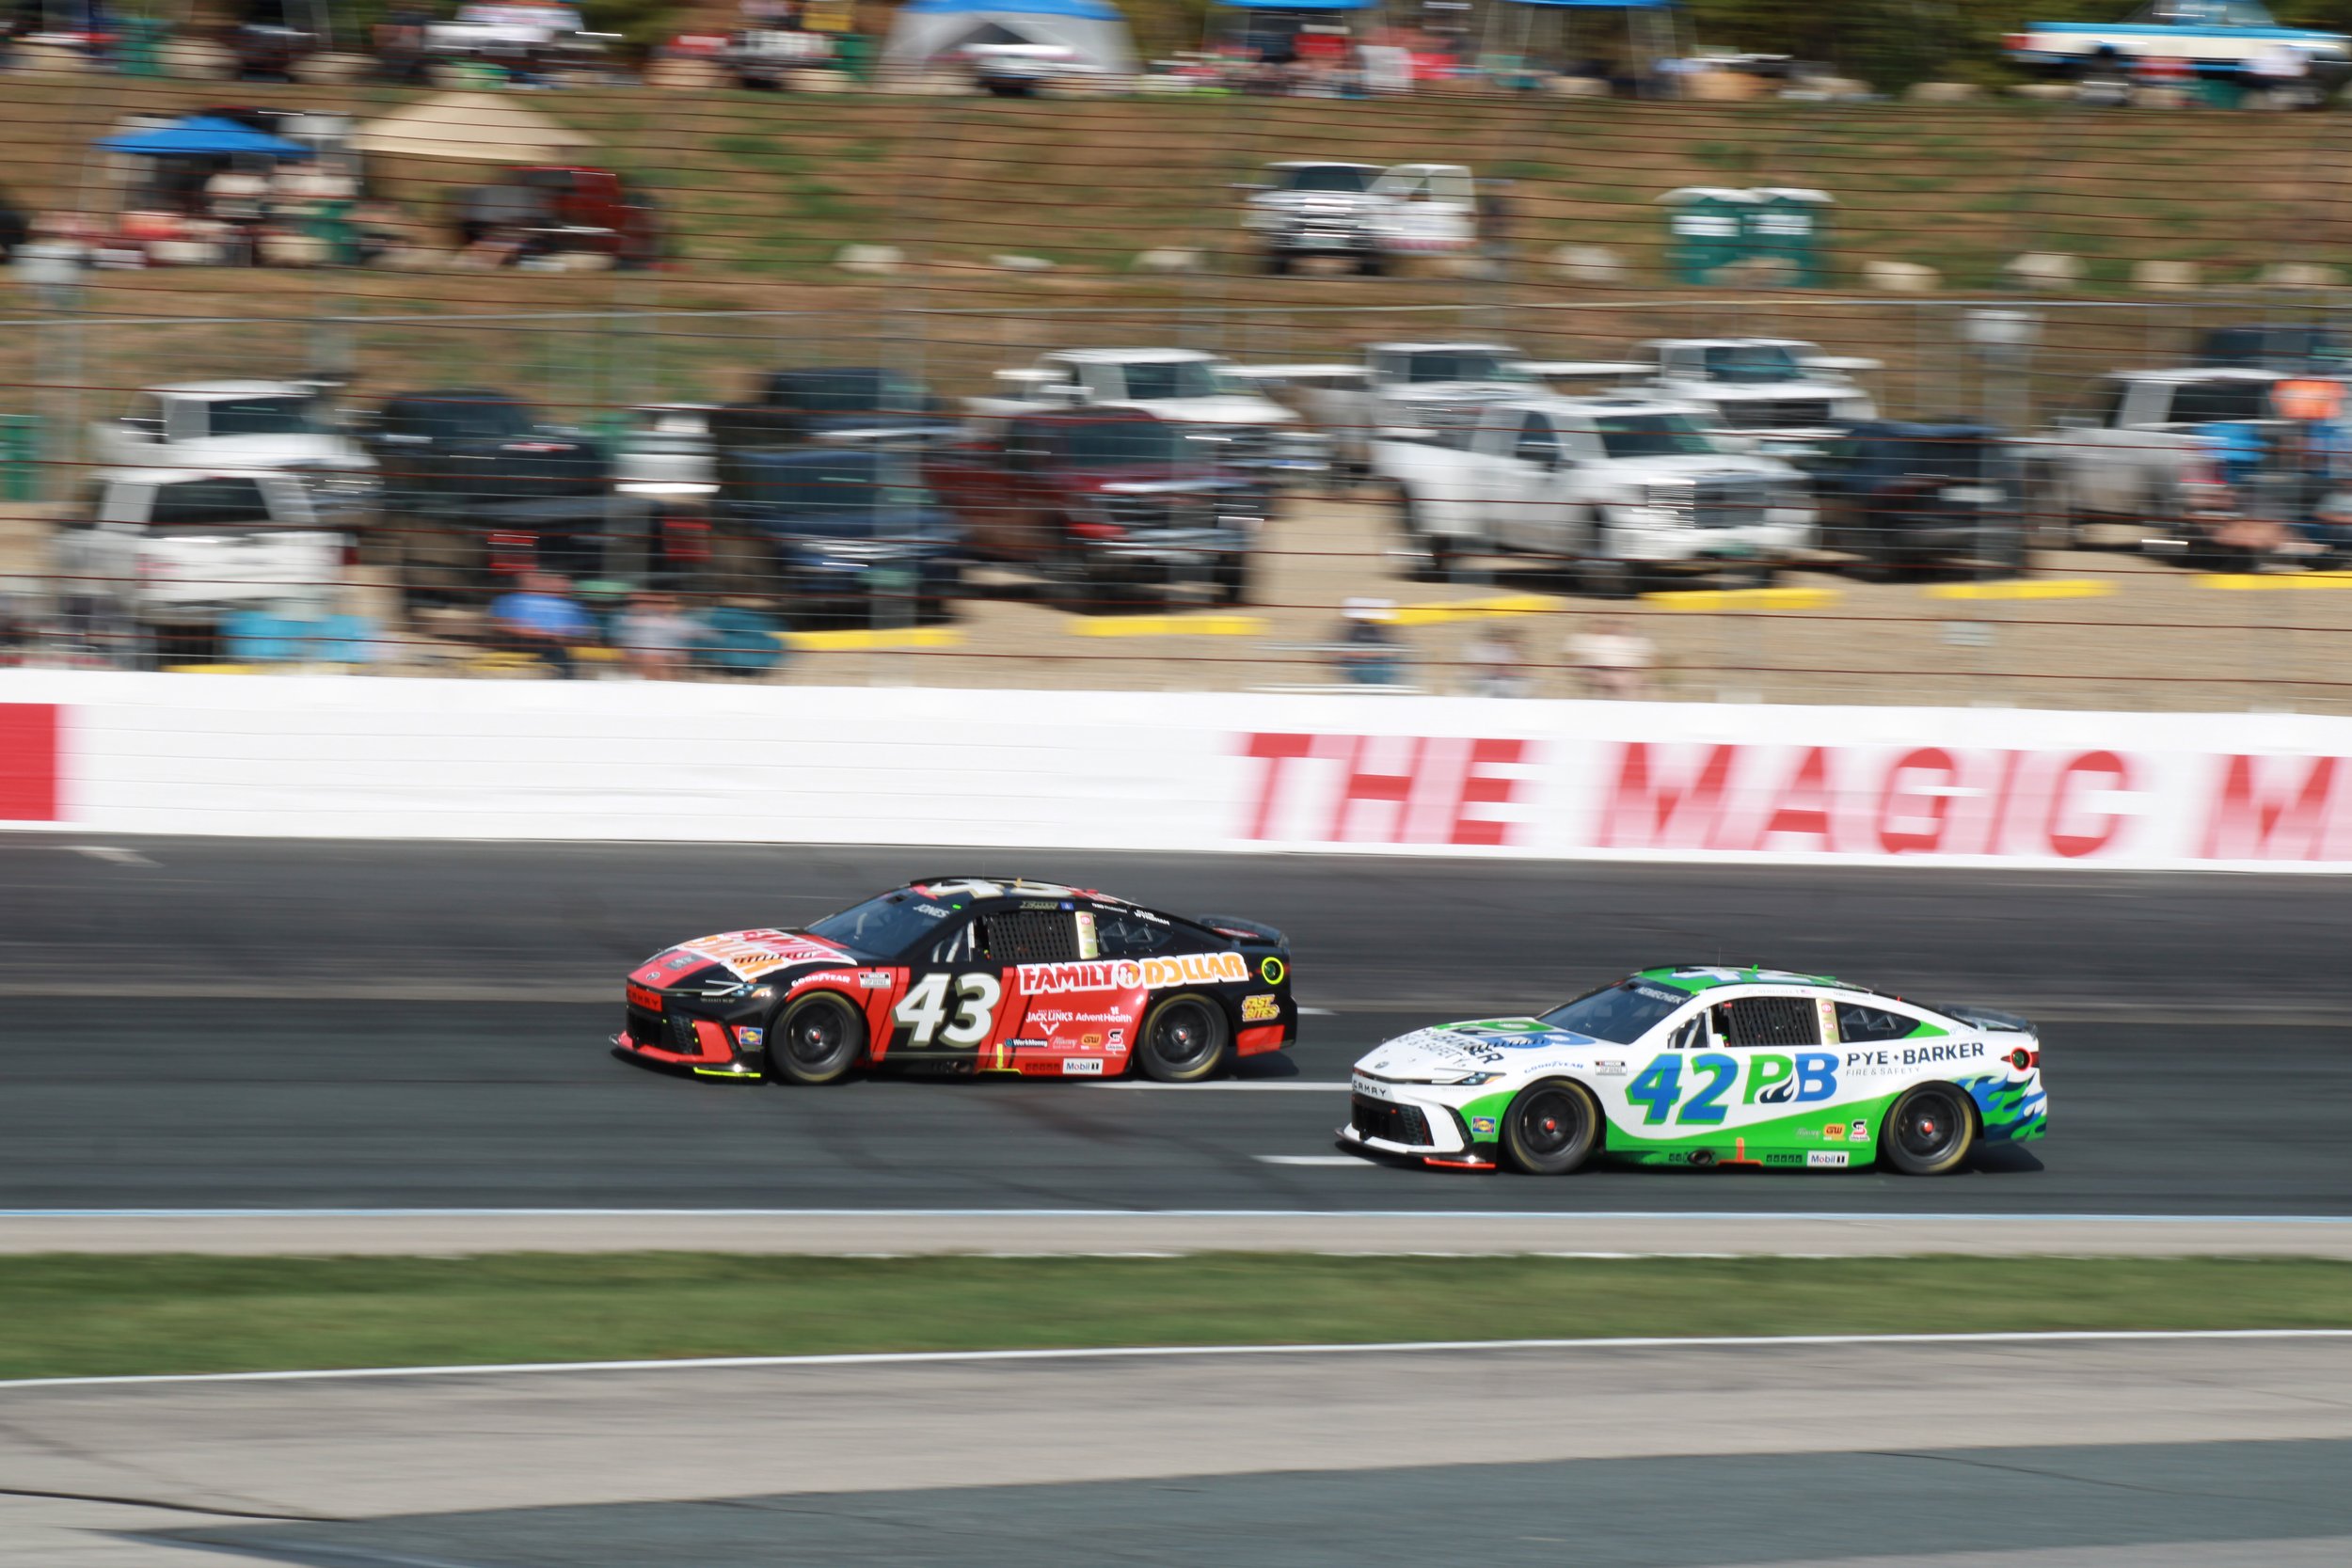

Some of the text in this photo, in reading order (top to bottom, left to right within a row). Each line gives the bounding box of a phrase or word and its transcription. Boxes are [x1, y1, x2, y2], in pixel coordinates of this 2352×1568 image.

[1234, 732, 1543, 846] THE
[1590, 741, 2137, 858] MAGIC
[913, 904, 950, 919] JONES
[791, 972, 850, 988] GOODYEAR
[1020, 953, 1248, 994] FAMILY DOLLAR
[891, 973, 1001, 1048] 43
[1075, 1012, 1133, 1023] AdventHealth
[1847, 1041, 1985, 1067] PYE BARKER
[1066, 1062, 1089, 1070] Mobil
[1846, 1068, 1867, 1077] FIRE
[1881, 1066, 1920, 1076] SAFETY
[1625, 1053, 1739, 1125] 42
[1811, 1154, 1836, 1164] Mobil
